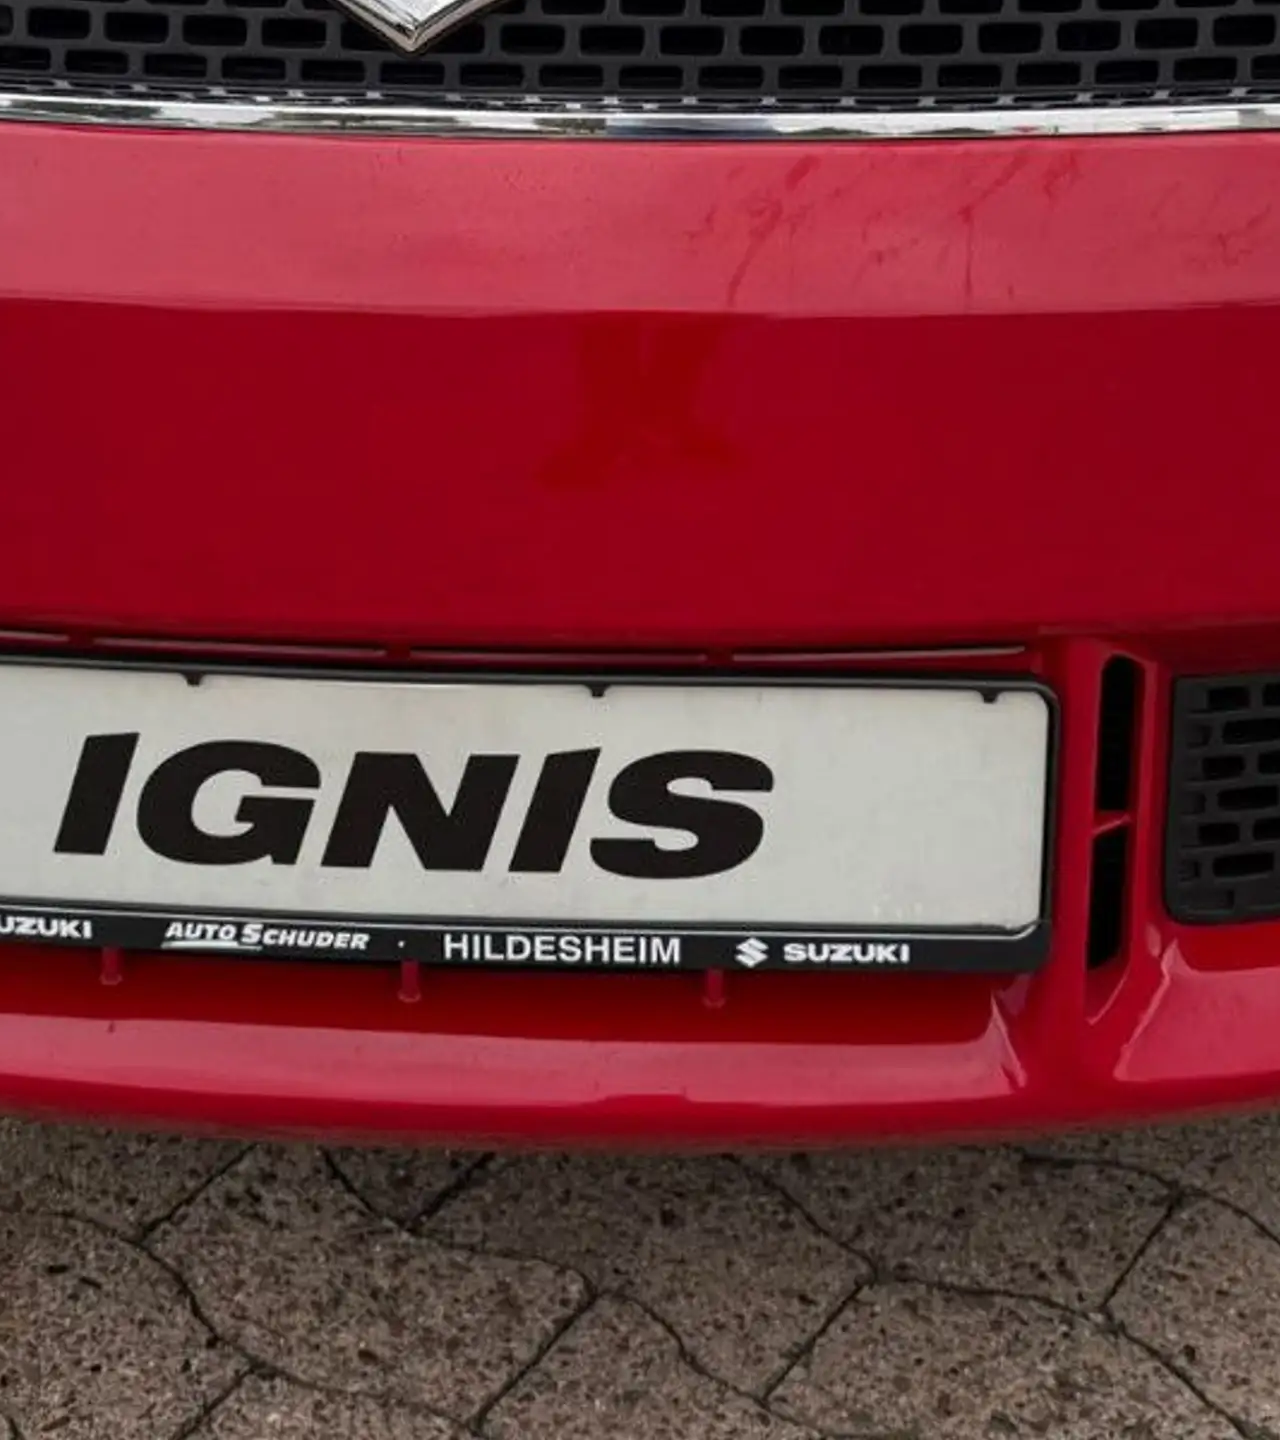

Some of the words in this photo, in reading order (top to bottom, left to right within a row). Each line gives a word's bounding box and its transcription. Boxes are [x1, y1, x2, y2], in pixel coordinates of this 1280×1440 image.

[53, 731, 775, 880] IGNIS
[165, 921, 236, 941] AUTO
[240, 922, 370, 950] SCHUDER
[443, 932, 681, 964] HILDESHEIM
[783, 942, 910, 964] SUZUKI
